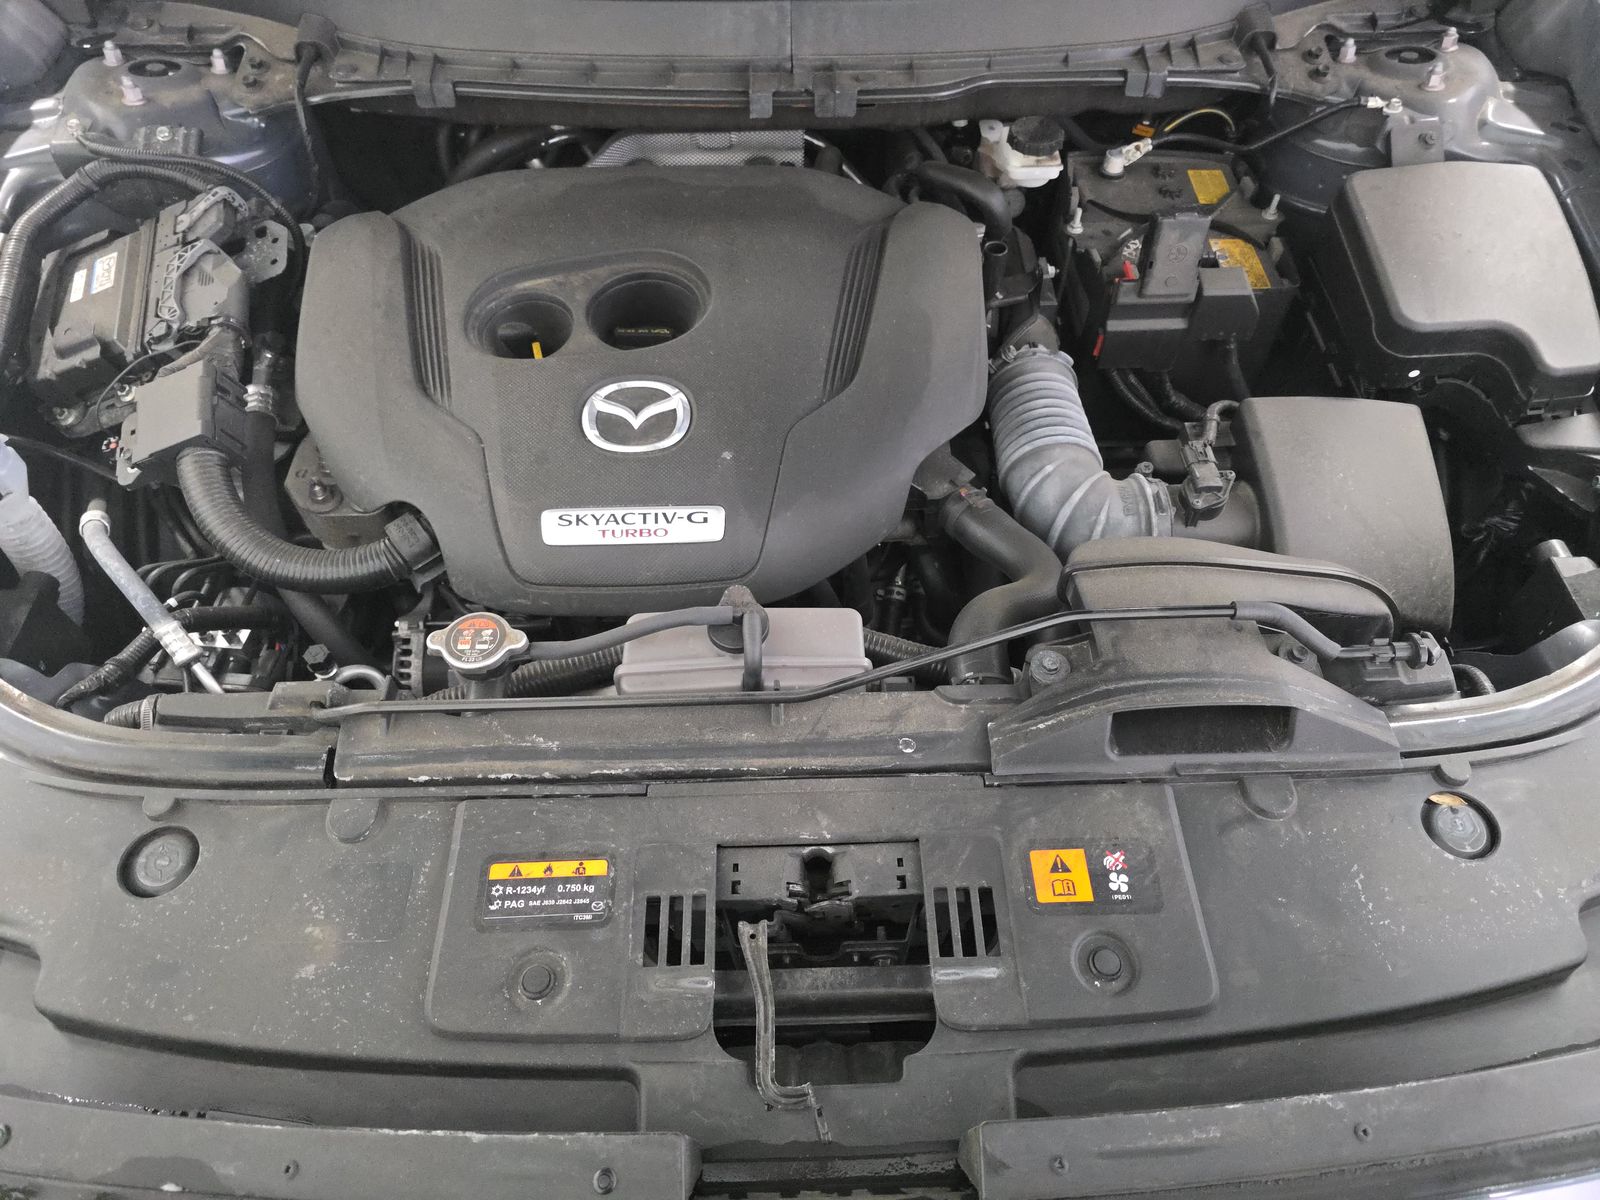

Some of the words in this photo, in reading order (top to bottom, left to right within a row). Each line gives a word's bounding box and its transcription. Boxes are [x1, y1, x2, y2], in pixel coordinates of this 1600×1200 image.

[557, 511, 709, 527] SKYACTIV-G
[597, 527, 669, 539] TURBO
[505, 884, 546, 895] R-1234yf
[557, 884, 582, 893] 0.750
[583, 883, 595, 894] kg
[504, 900, 525, 909] PAG
